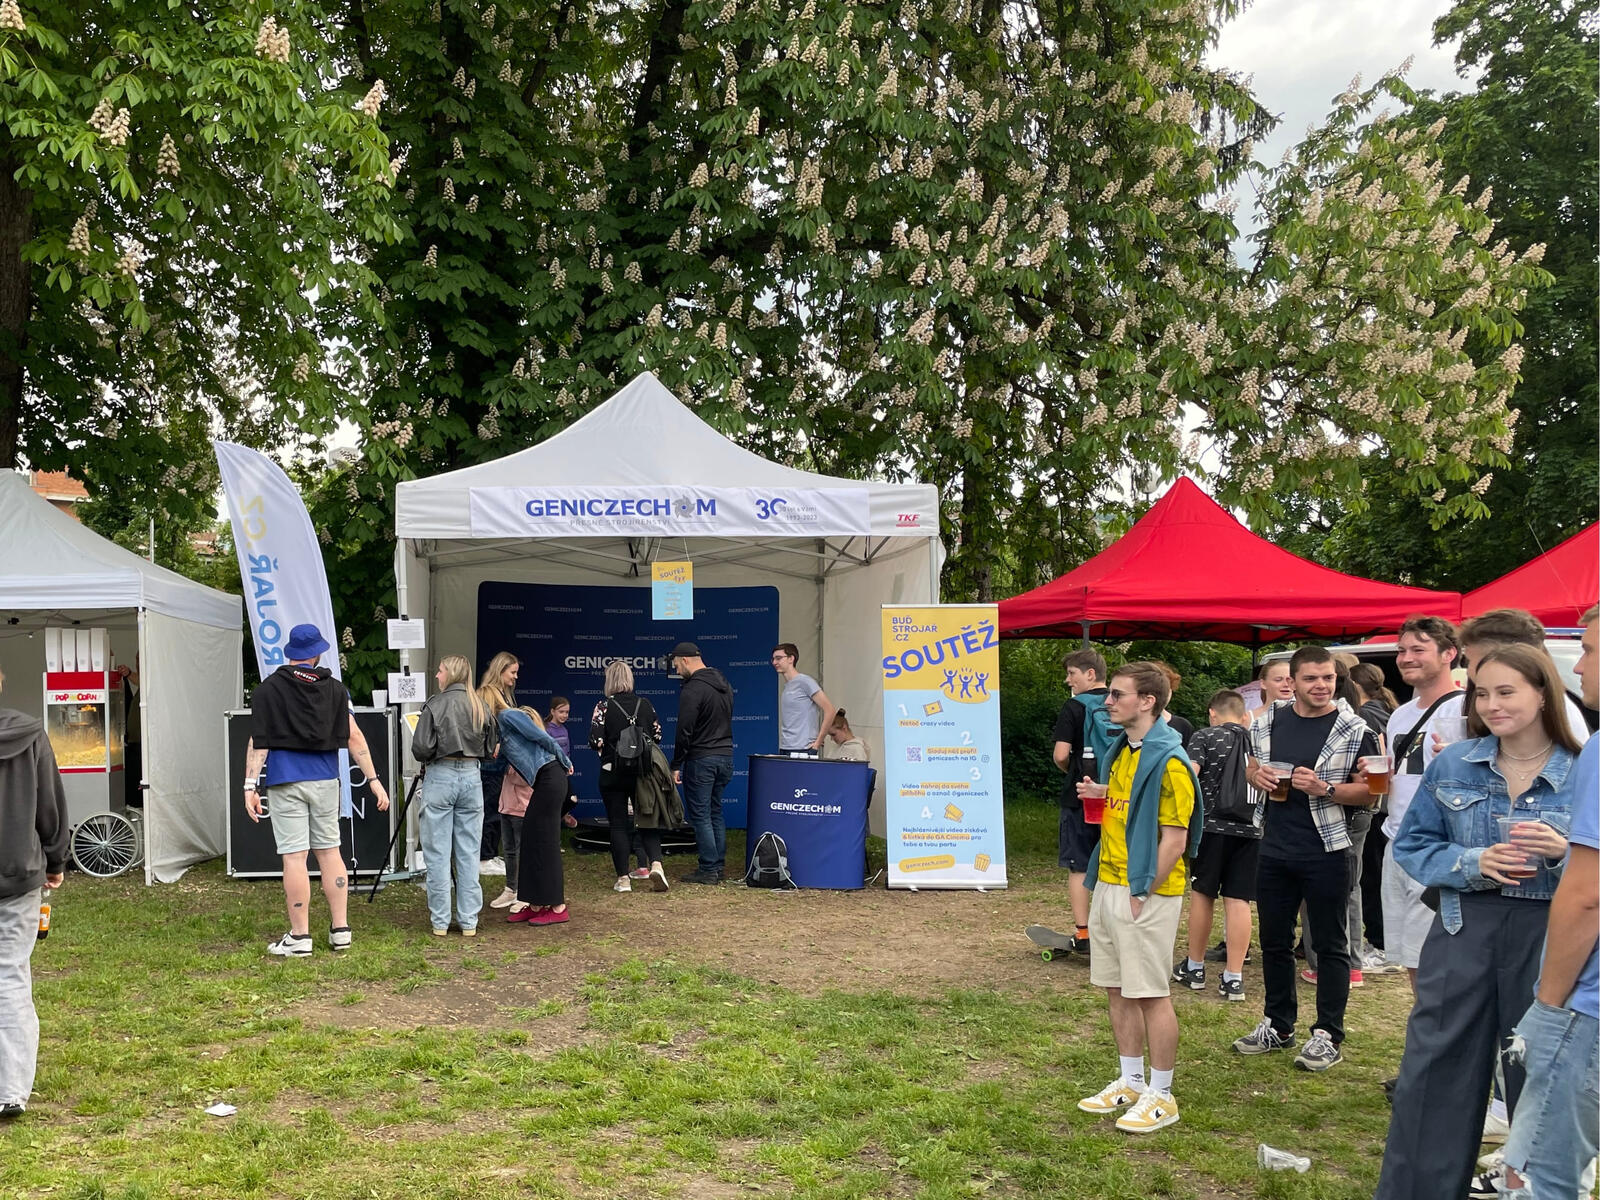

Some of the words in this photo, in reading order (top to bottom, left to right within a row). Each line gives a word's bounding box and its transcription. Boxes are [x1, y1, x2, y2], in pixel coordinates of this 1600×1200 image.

[897, 514, 920, 522] TKF
[892, 615, 912, 624] BUĎ
[892, 624, 938, 633] STROJAŘ
[883, 619, 1000, 678] SOUTĚŽ
[55, 693, 69, 702] POP
[77, 693, 97, 701] CORN
[898, 703, 908, 716] 1
[960, 731, 974, 745] 2
[969, 766, 982, 780] 3
[920, 805, 933, 819] 4
